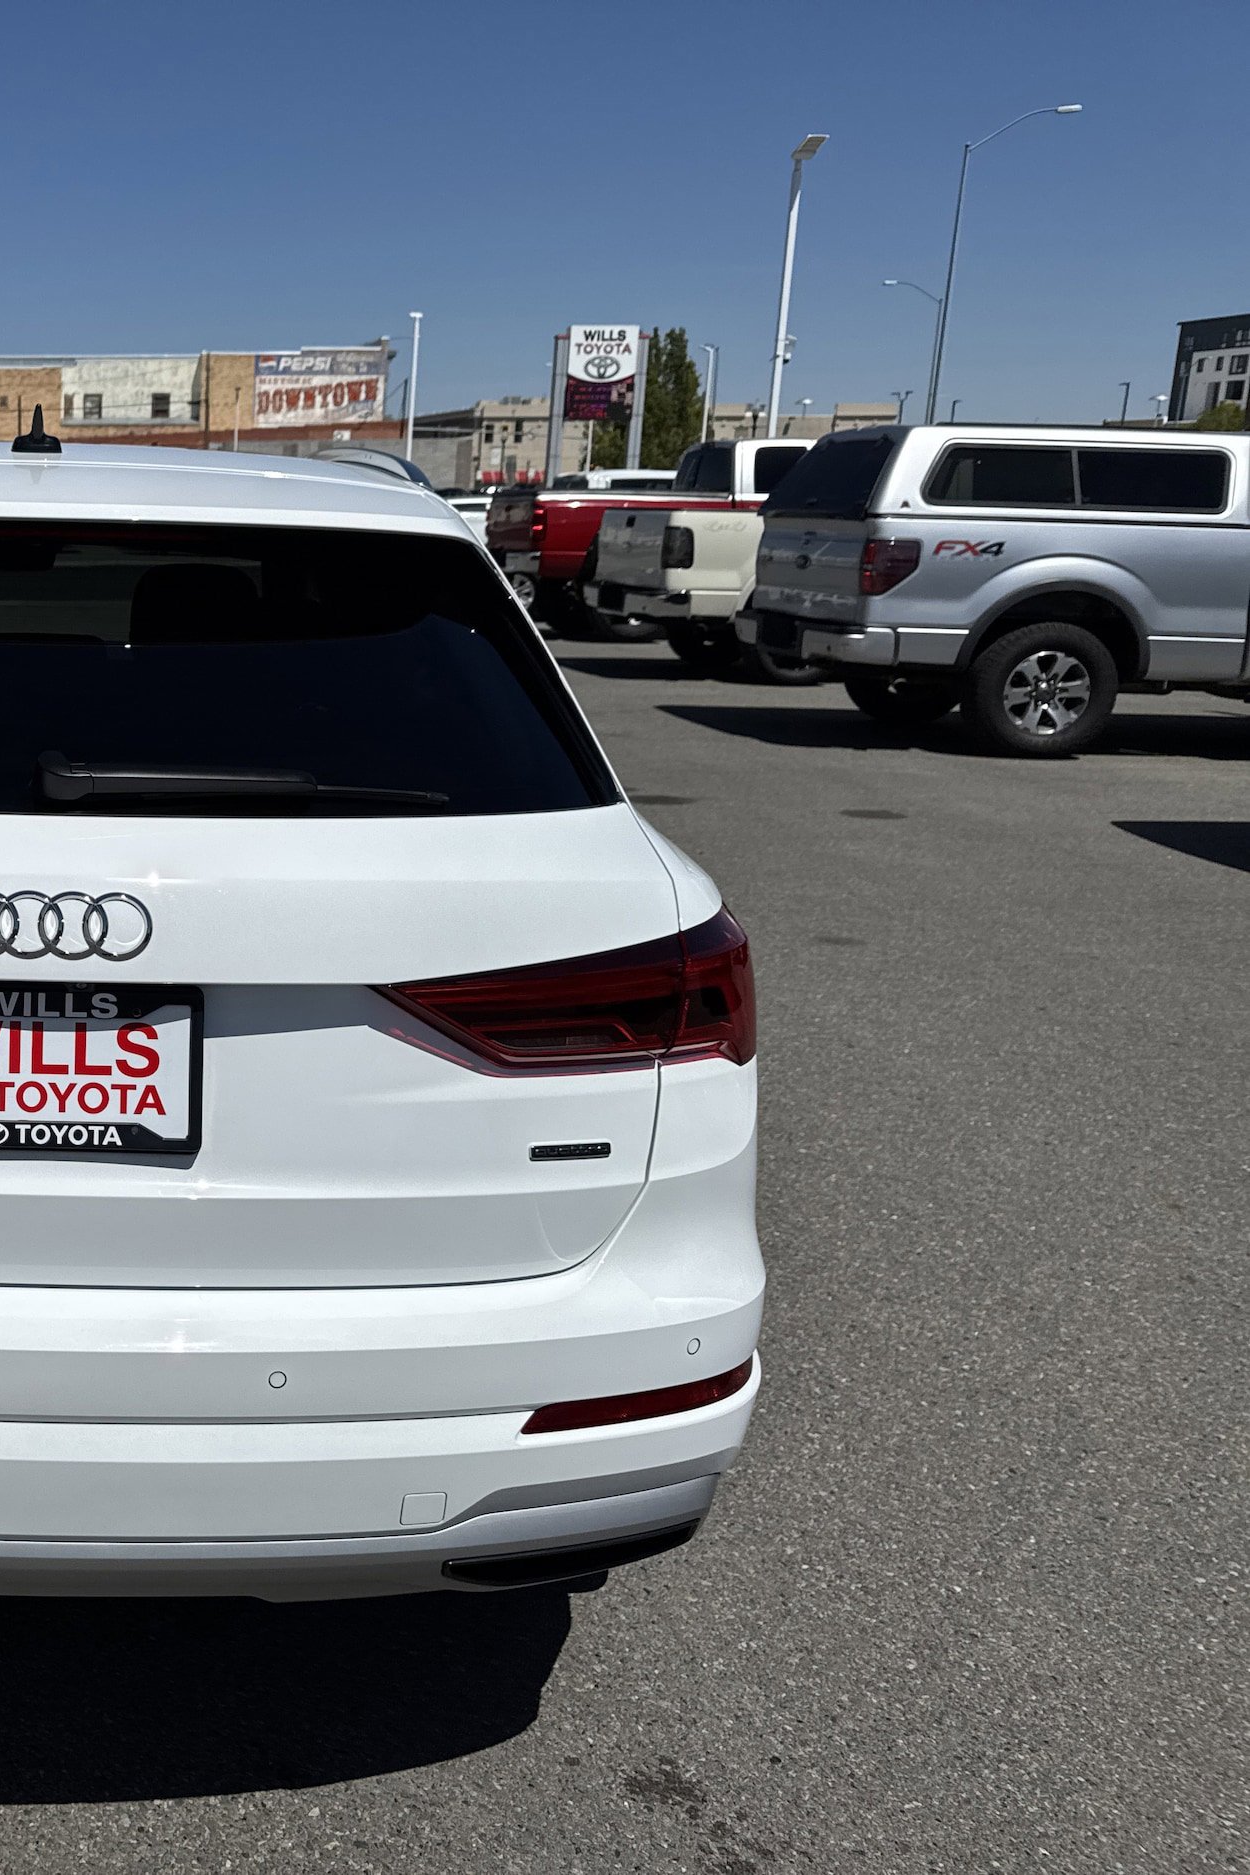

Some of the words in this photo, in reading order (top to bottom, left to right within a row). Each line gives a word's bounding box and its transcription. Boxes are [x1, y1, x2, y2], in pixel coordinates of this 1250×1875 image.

[583, 330, 626, 341] WILLS
[575, 343, 632, 355] TOYOTA
[278, 356, 332, 372] PEPSI
[257, 378, 379, 414] DOWNTOWN
[932, 540, 1006, 557] FX4
[15, 1124, 122, 1146] TOYOTA
